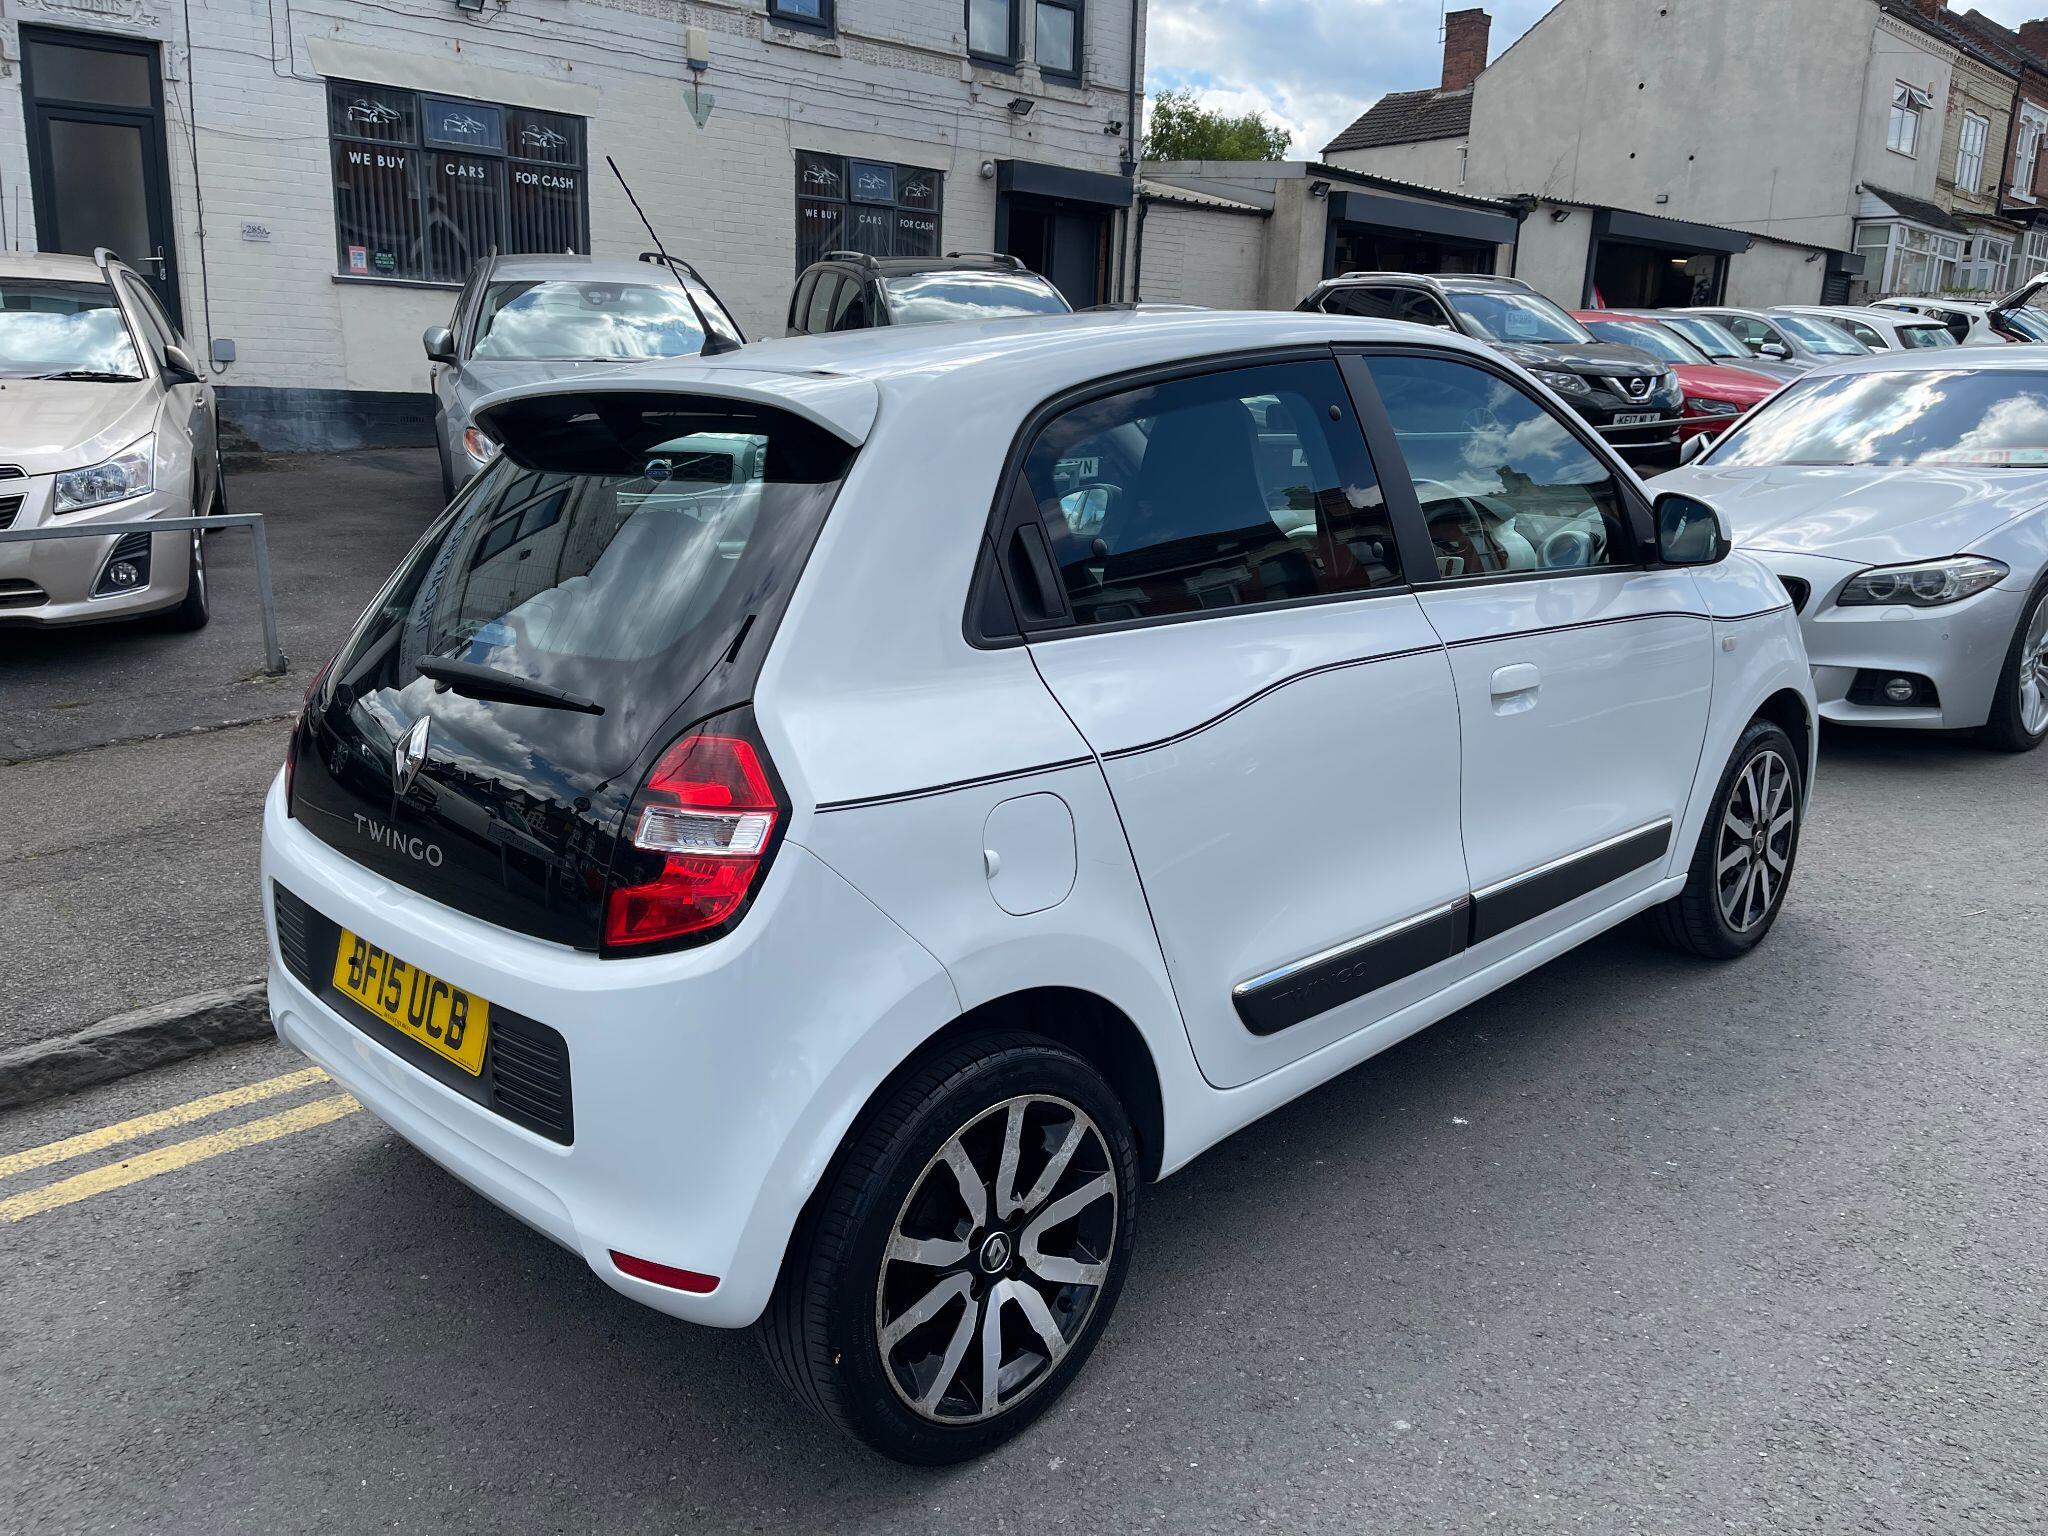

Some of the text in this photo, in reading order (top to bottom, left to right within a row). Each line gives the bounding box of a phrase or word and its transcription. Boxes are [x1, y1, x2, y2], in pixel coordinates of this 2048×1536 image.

[348, 151, 405, 170] WE BUY
[445, 163, 485, 179] CARS
[515, 171, 574, 190] FOR CASH
[804, 208, 838, 220] WE BUY
[858, 214, 882, 225] CARS
[899, 219, 934, 231] FOR CASH
[353, 813, 443, 867] TWINGO
[347, 935, 469, 1052] BF15 UCB
